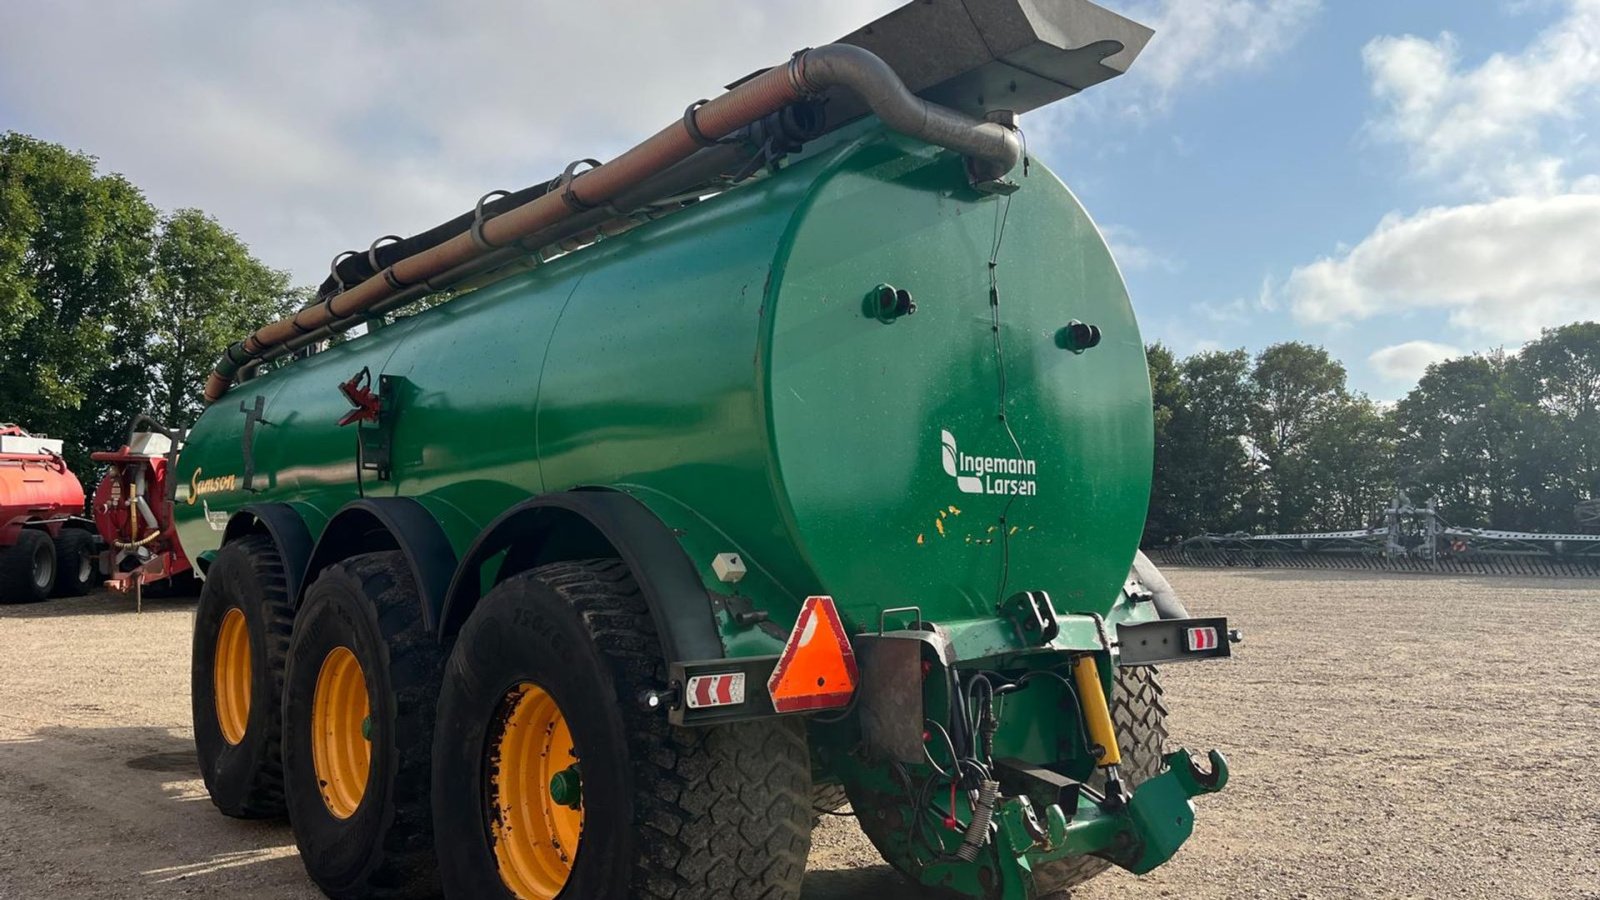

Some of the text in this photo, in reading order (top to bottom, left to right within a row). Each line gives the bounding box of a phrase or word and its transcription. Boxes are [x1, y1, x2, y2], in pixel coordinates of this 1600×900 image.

[960, 452, 1036, 476] Ingemann
[187, 467, 236, 505] Samson
[986, 475, 1036, 496] Larsen
